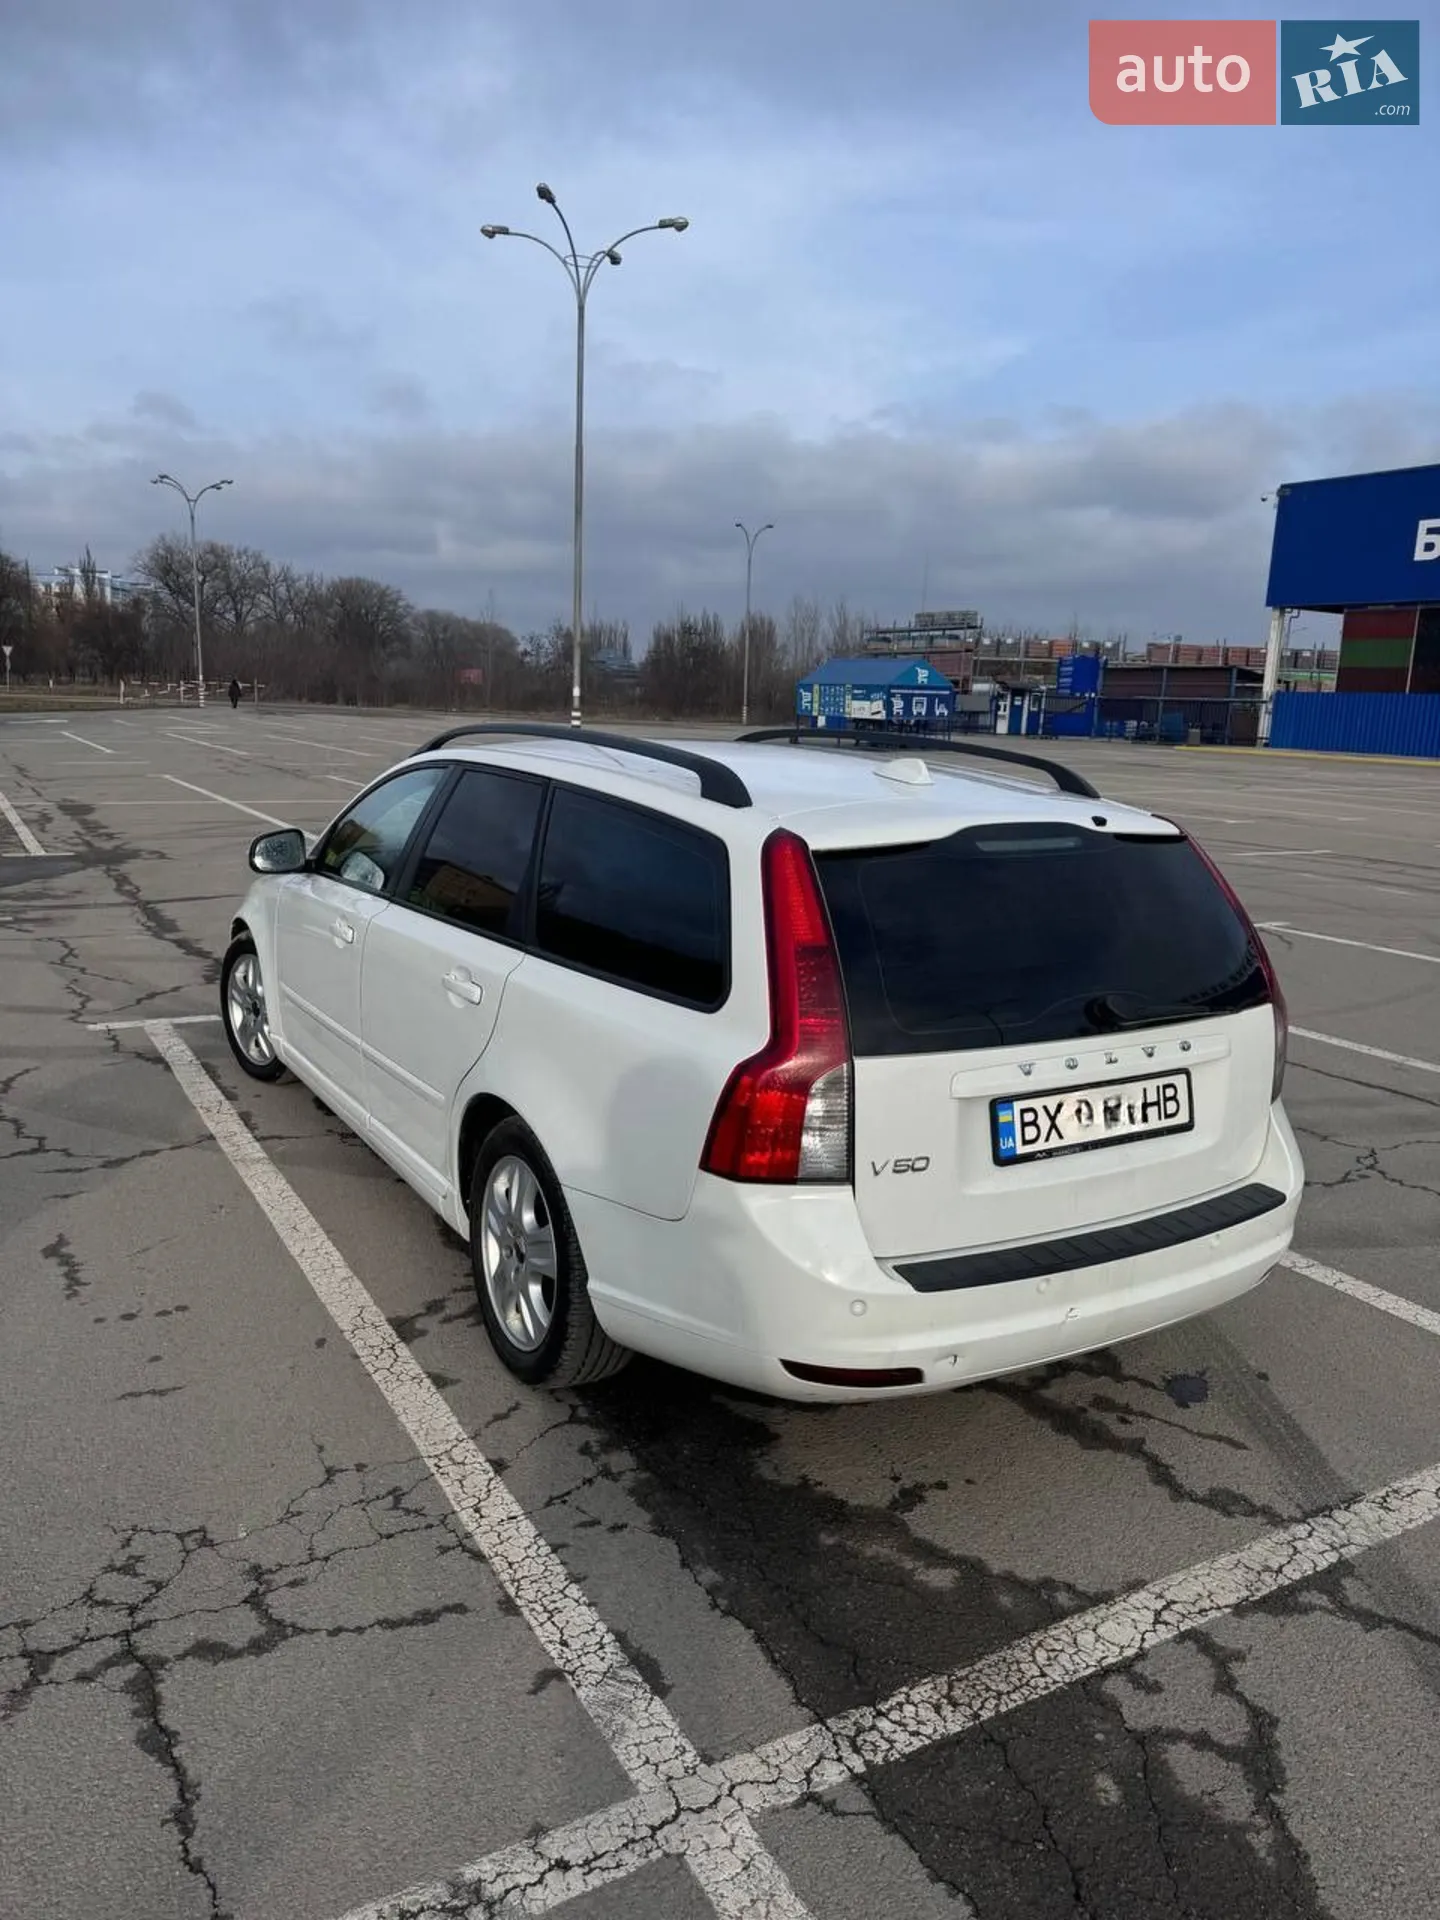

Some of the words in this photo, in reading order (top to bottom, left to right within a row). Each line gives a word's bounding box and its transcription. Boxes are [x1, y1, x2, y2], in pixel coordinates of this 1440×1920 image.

[1017, 1039, 1193, 1077] VOLVO
[1000, 1137, 1015, 1150] UA
[871, 1155, 931, 1176] V50
